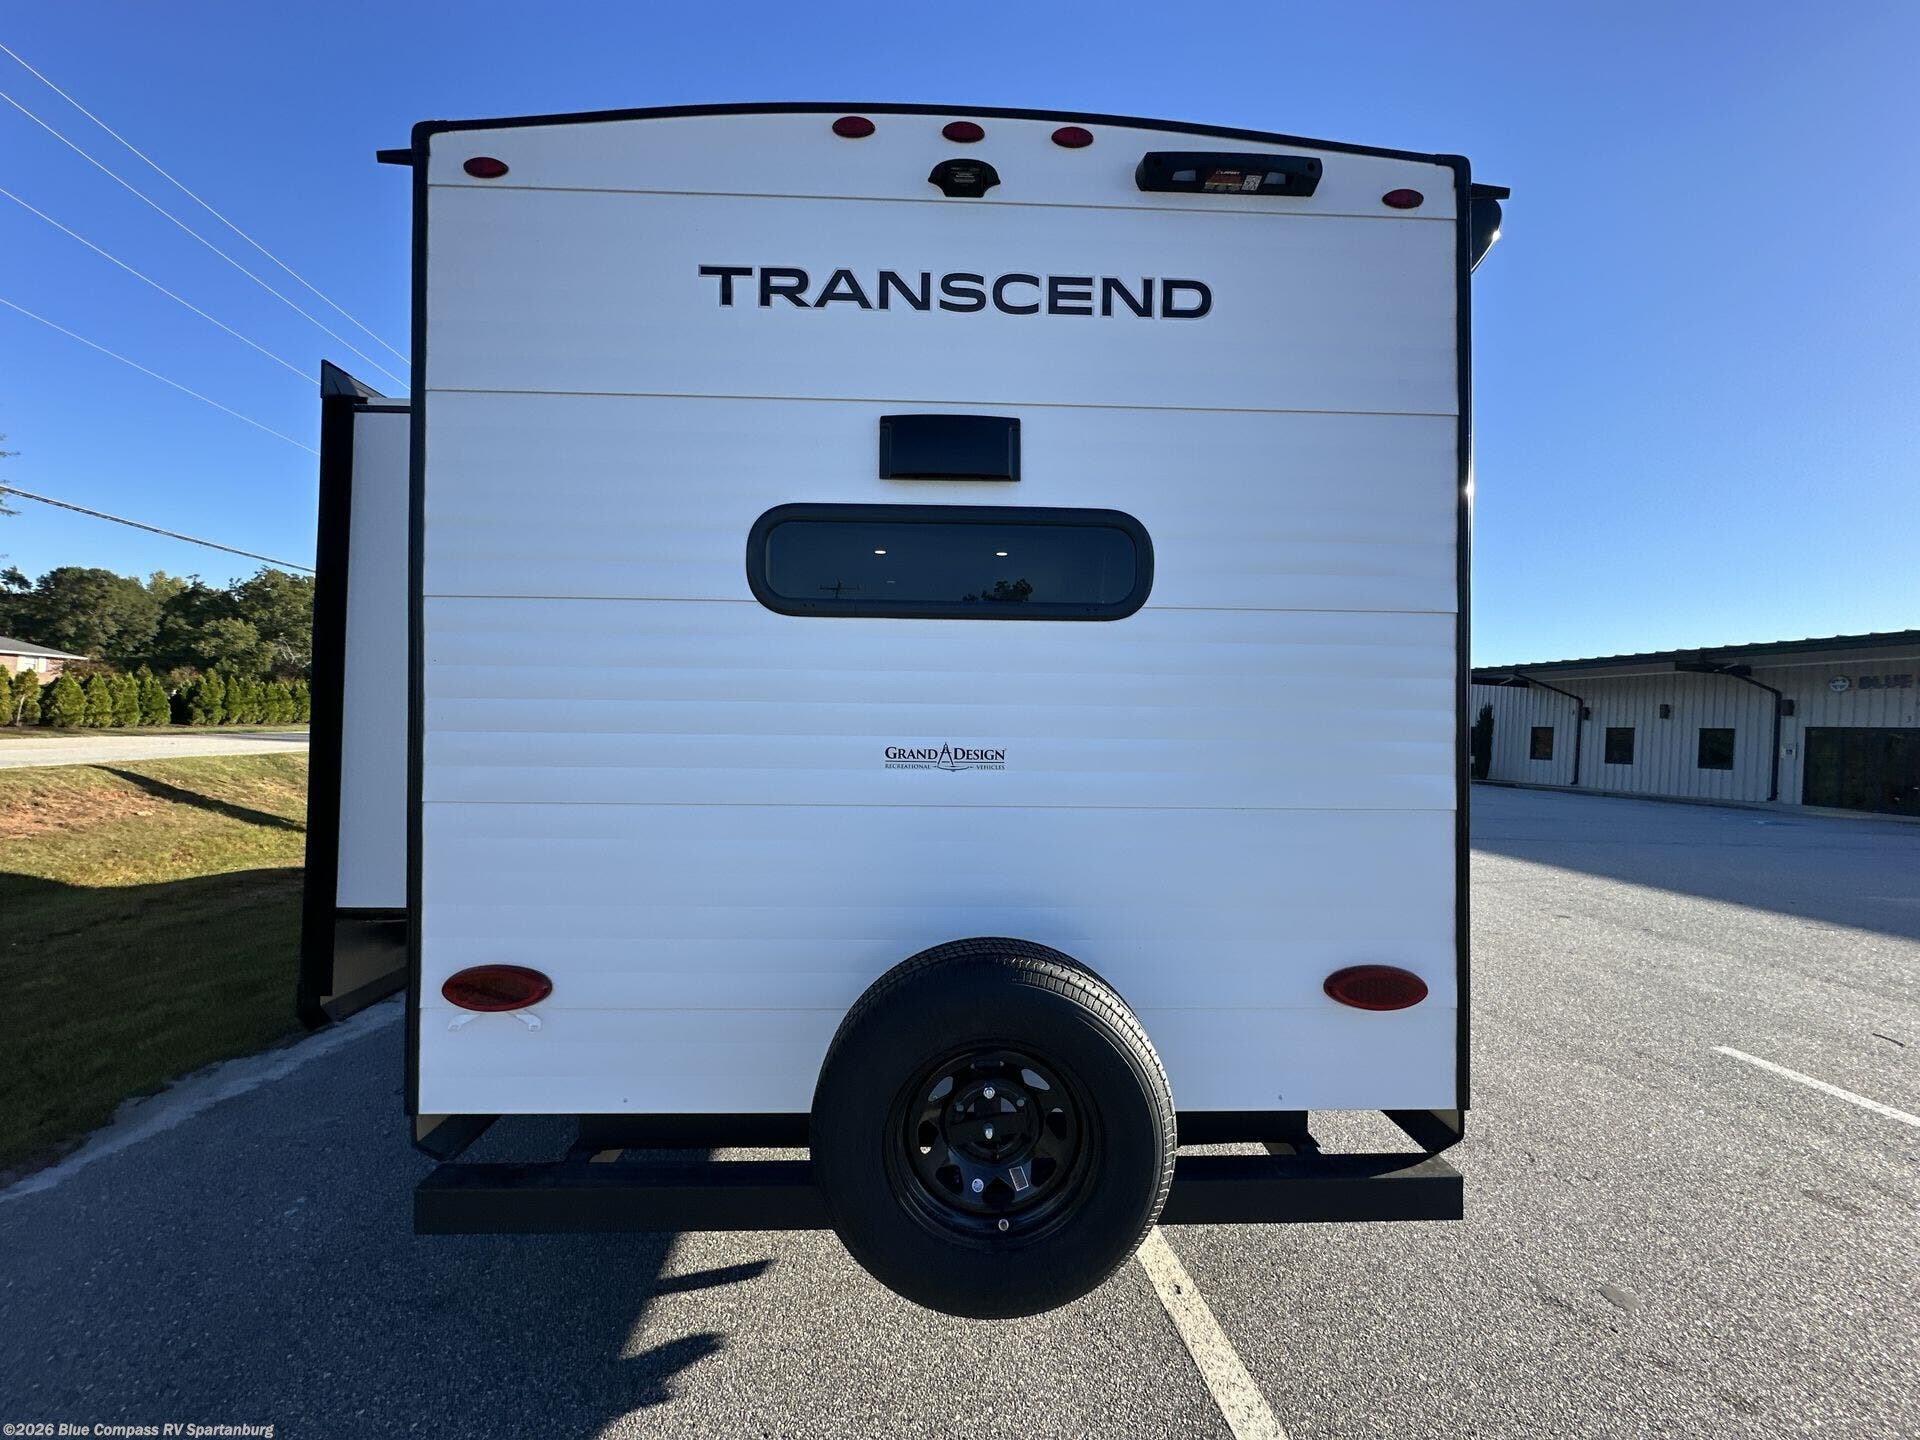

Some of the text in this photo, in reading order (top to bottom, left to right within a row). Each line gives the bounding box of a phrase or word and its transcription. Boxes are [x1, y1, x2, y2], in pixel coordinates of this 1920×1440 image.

[698, 264, 1213, 321] TRANSCEND
[884, 746, 1006, 761] GRAND DESIGN
